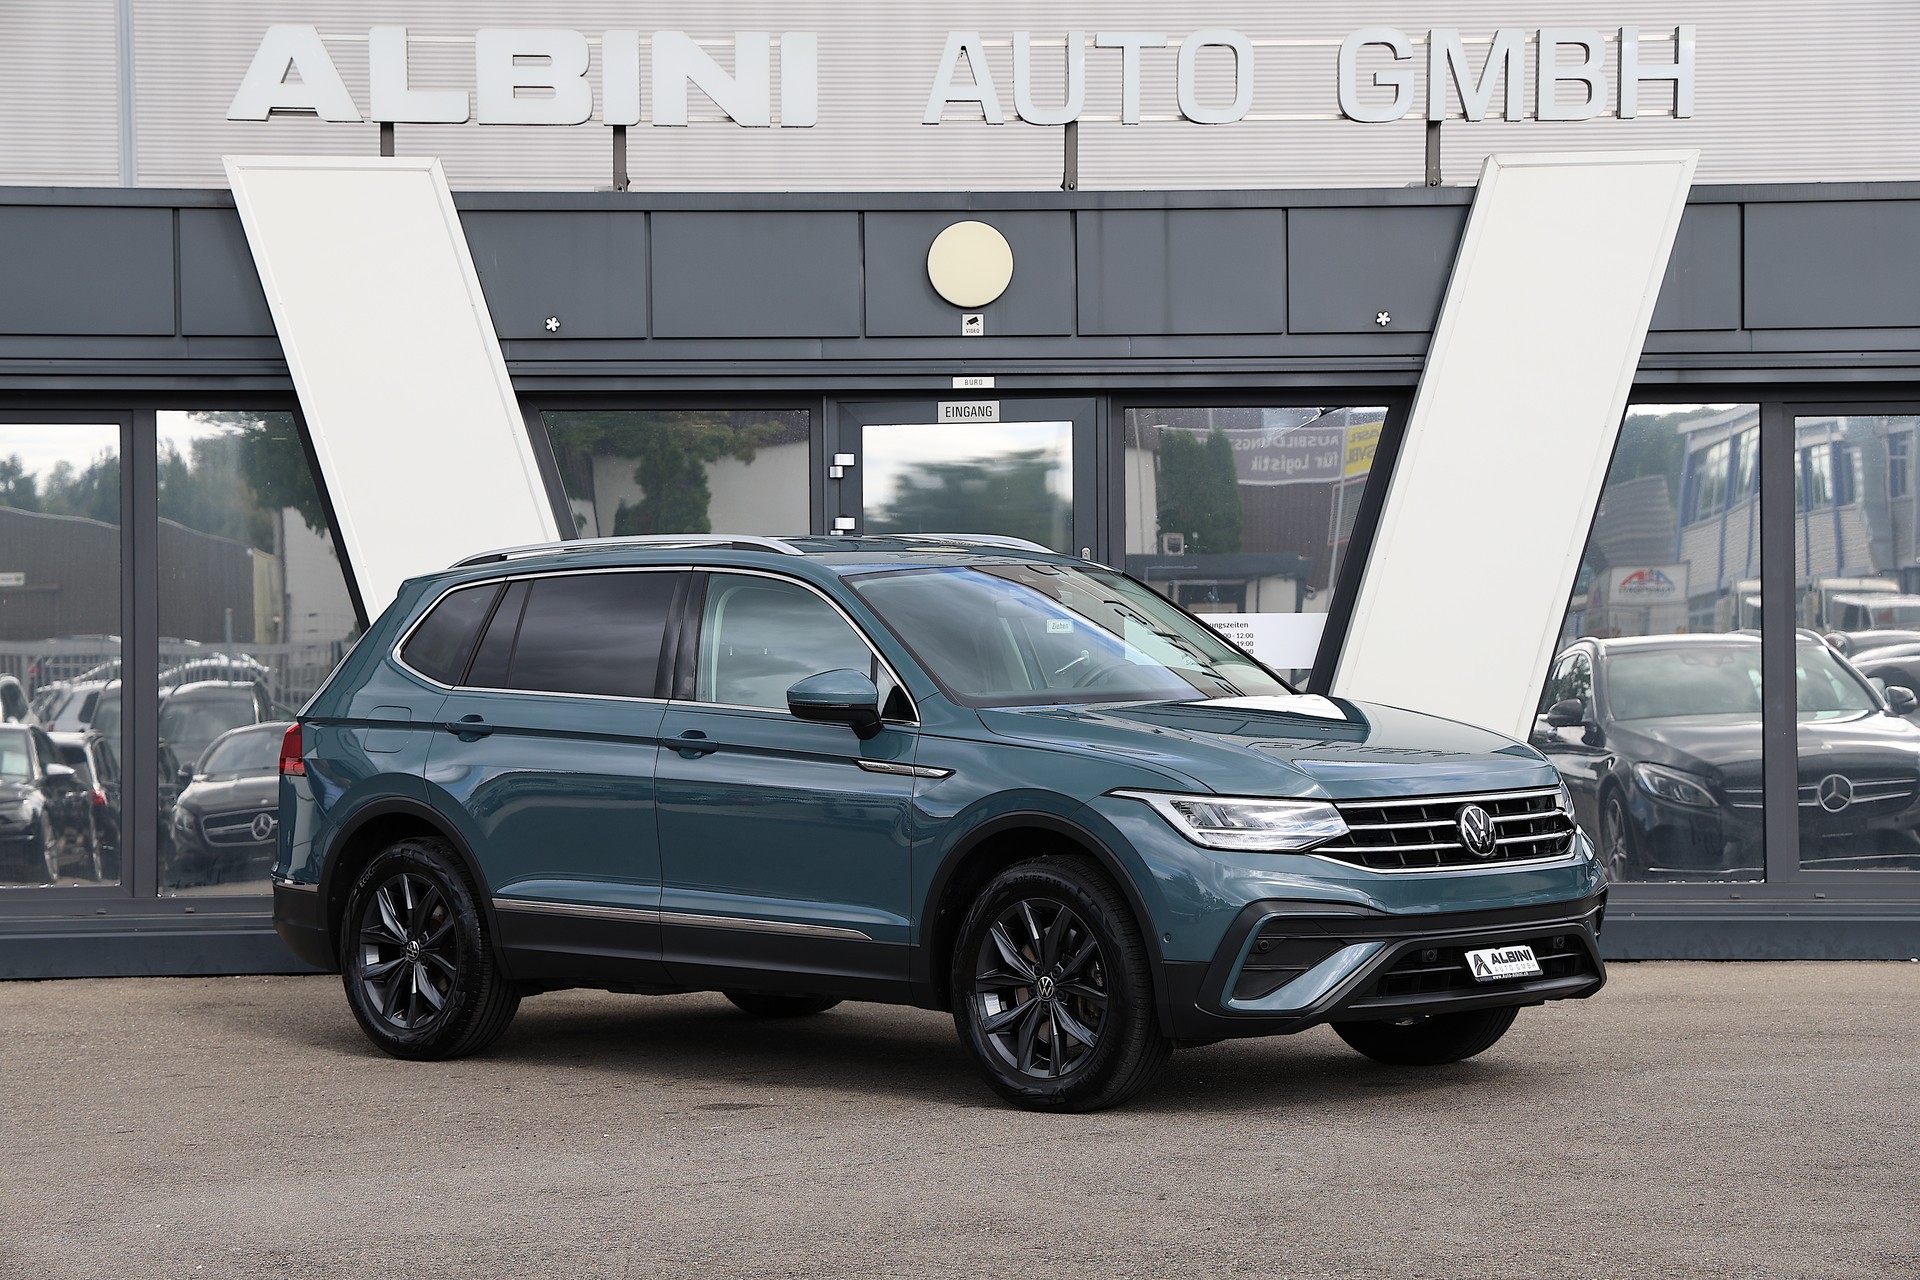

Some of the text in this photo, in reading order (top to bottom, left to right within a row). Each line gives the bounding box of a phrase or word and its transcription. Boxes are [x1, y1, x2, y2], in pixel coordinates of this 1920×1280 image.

[226, 24, 1698, 128] ALBINI AUTO GMBH
[964, 378, 983, 386] BÜRO
[945, 405, 993, 418] EINGANG
[1209, 621, 1249, 630] ungszeiten
[1491, 949, 1533, 965] ALBINI
[1494, 964, 1514, 973] AUTO
